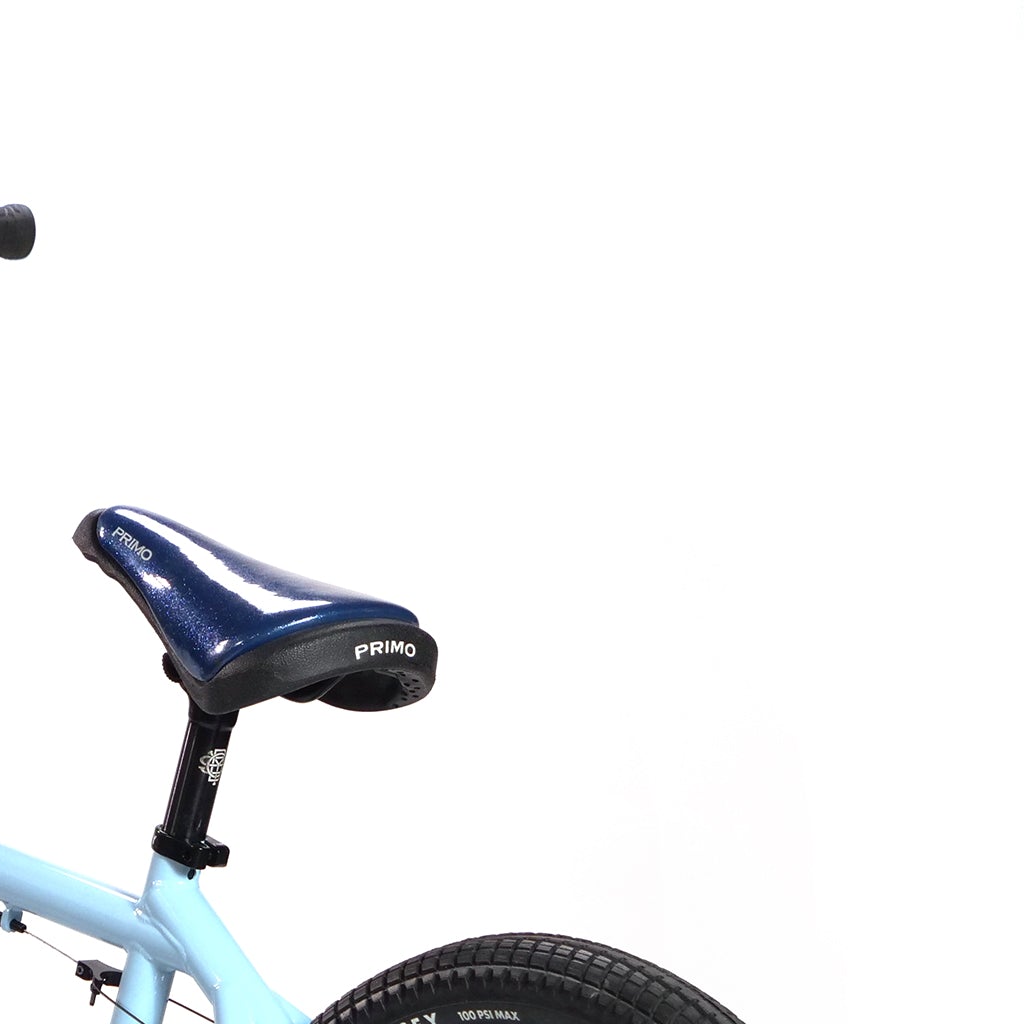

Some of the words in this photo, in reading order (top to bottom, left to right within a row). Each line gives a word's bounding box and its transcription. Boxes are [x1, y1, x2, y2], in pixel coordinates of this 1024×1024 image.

[111, 526, 153, 561] PRIMO
[354, 640, 416, 660] PRIMO
[457, 1010, 477, 1021] 100
[476, 1009, 495, 1020] PSI
[494, 1009, 521, 1021] MAX
